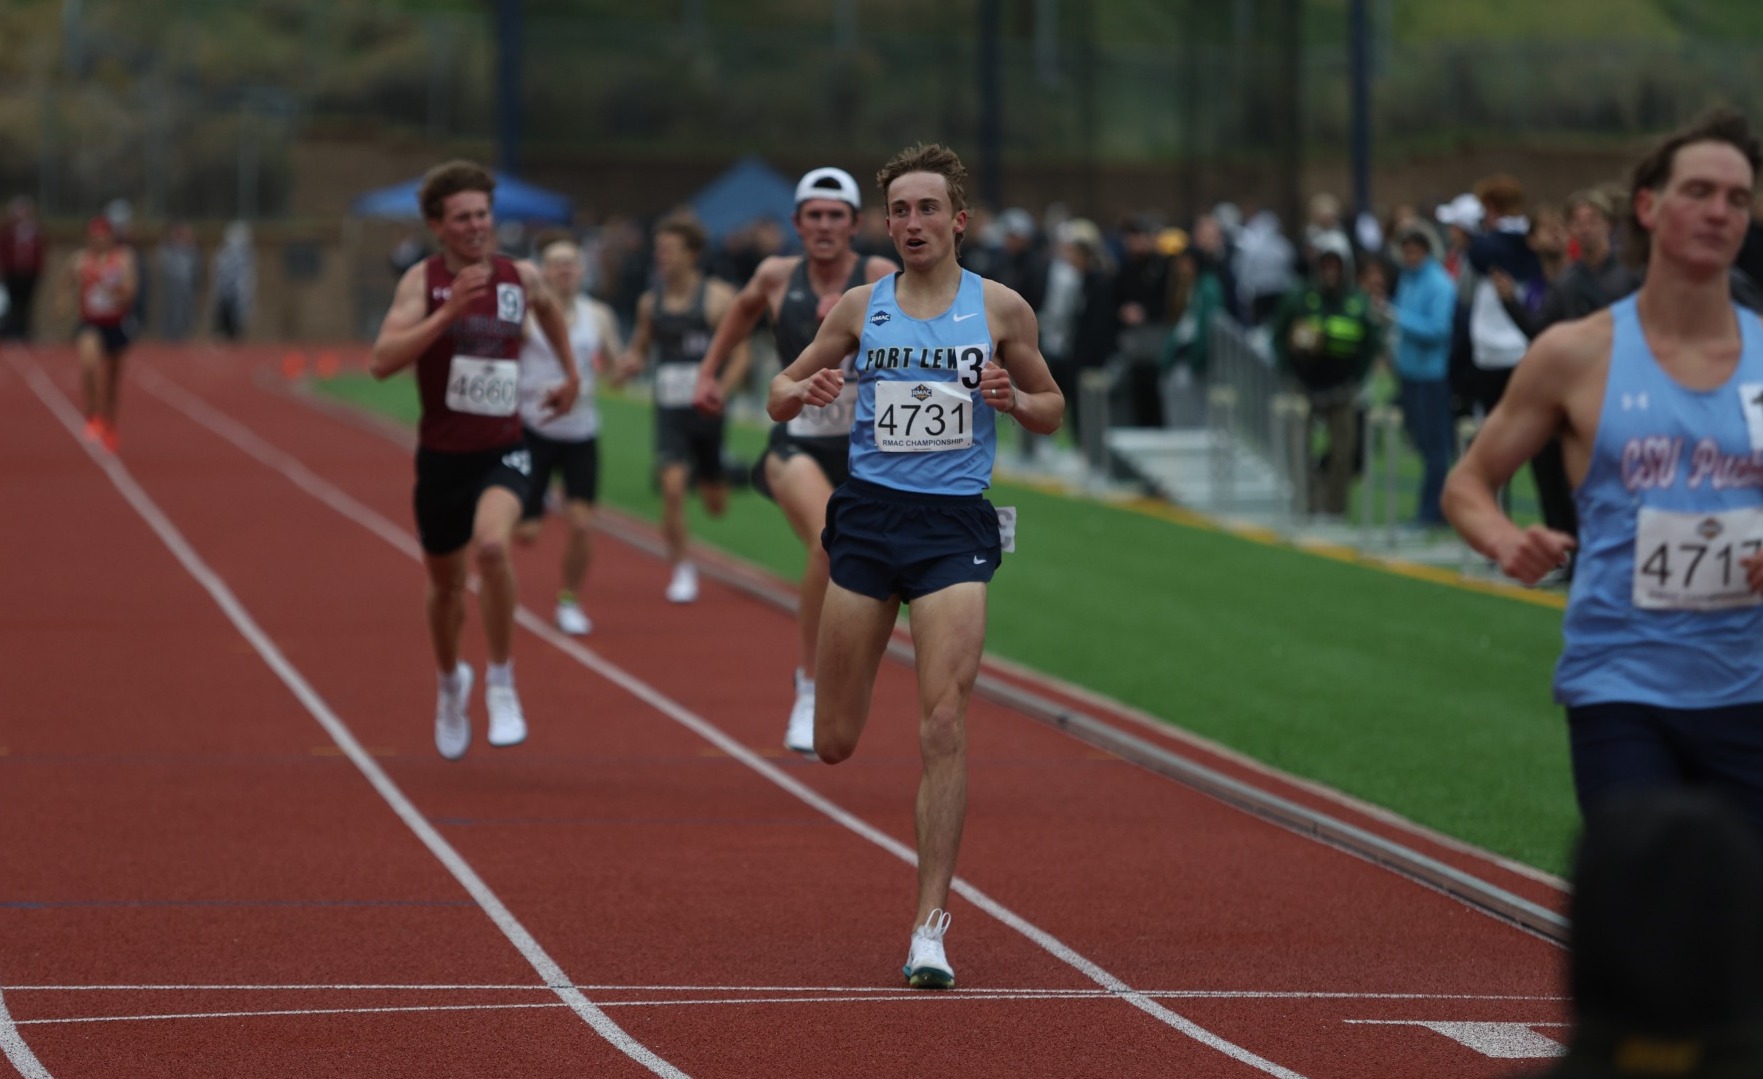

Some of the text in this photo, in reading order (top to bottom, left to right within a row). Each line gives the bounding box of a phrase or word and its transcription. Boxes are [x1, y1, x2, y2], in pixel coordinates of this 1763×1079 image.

[503, 289, 519, 320] 9
[870, 314, 891, 323] RMAC
[865, 347, 914, 372] FORT
[961, 347, 984, 390] 3
[449, 374, 515, 406] 4660
[911, 389, 932, 398] RMAC
[878, 402, 964, 437] 4731
[882, 437, 964, 447] RMAC CHAMPIONSHIP
